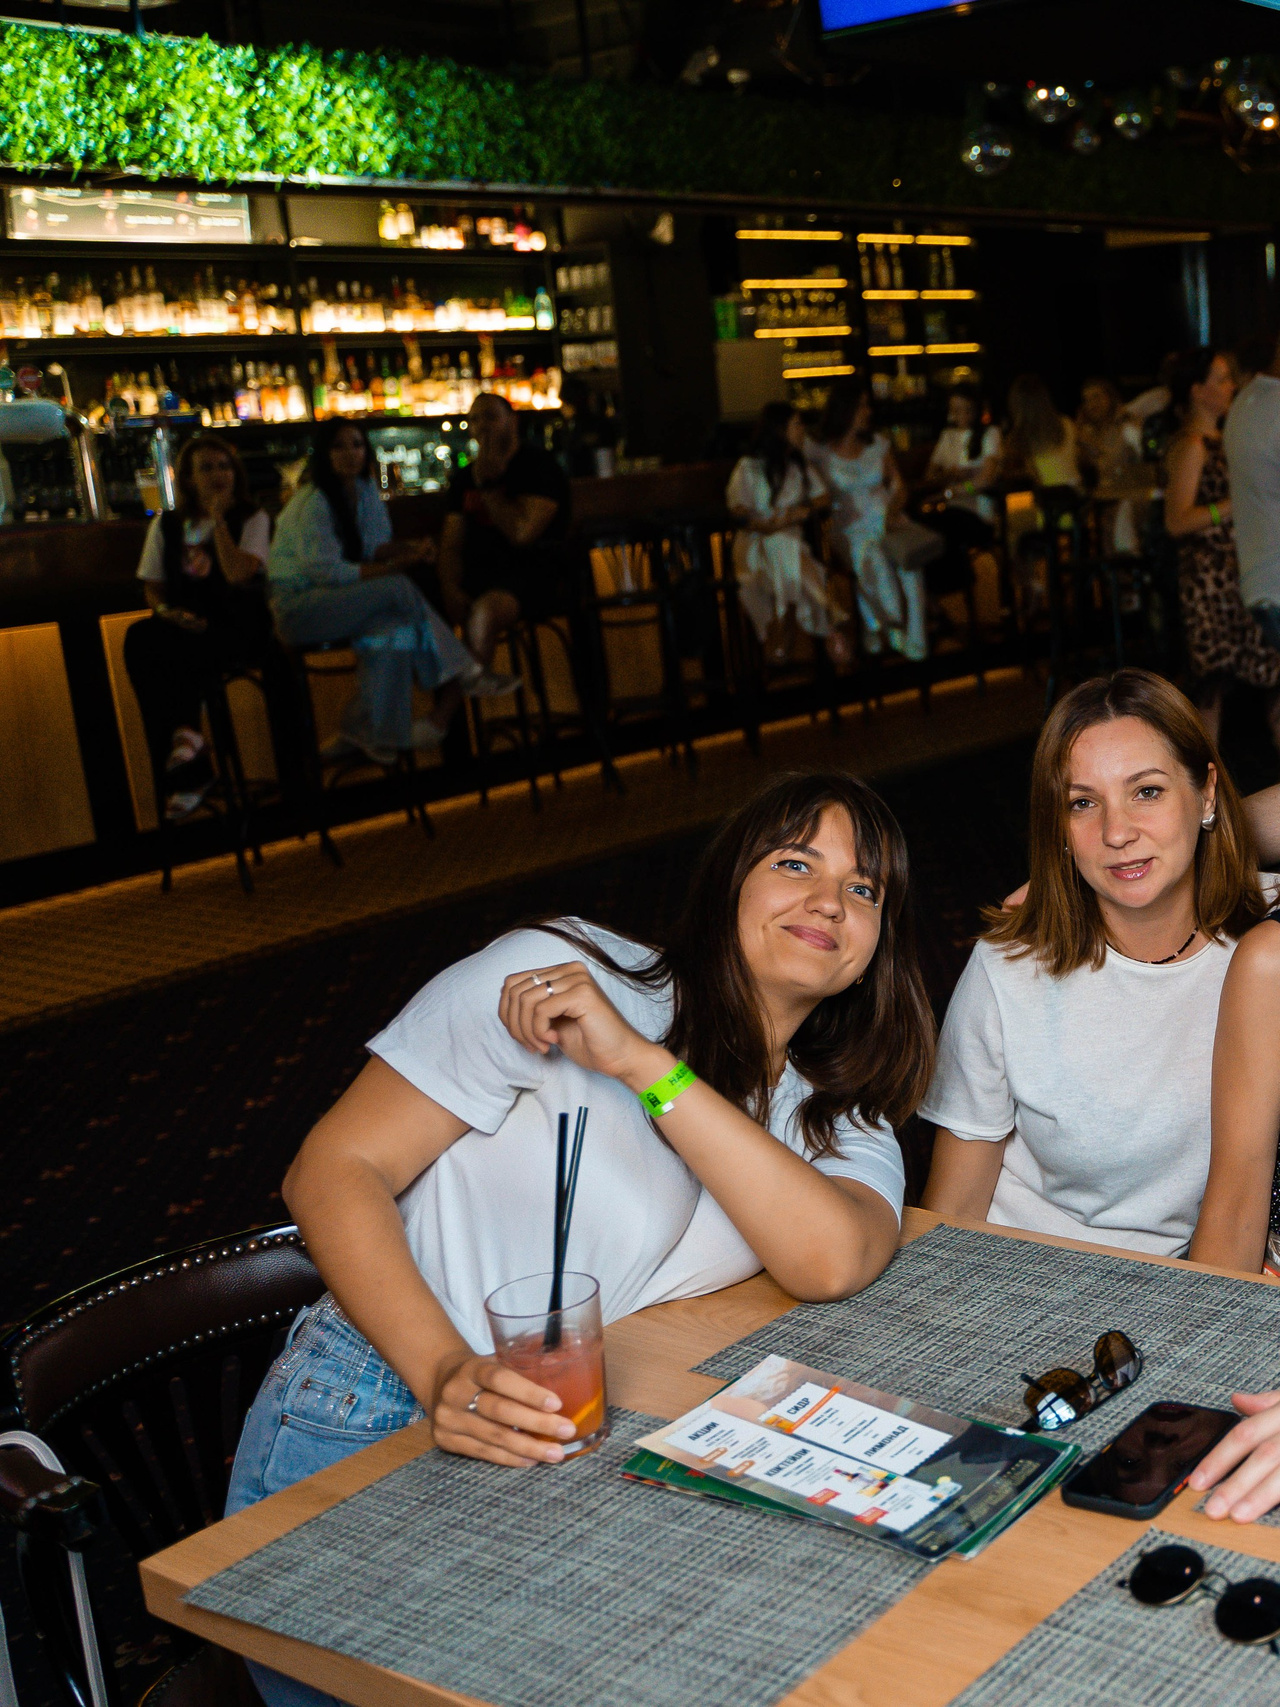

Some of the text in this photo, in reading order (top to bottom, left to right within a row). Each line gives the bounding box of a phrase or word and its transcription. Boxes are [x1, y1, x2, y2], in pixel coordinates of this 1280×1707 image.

[786, 1397, 811, 1415] СИДР
[687, 1421, 720, 1441] АКЦИИ
[863, 1425, 910, 1457] ЛИМОНАД
[764, 1448, 811, 1477] КОКТЕЙЛИ
